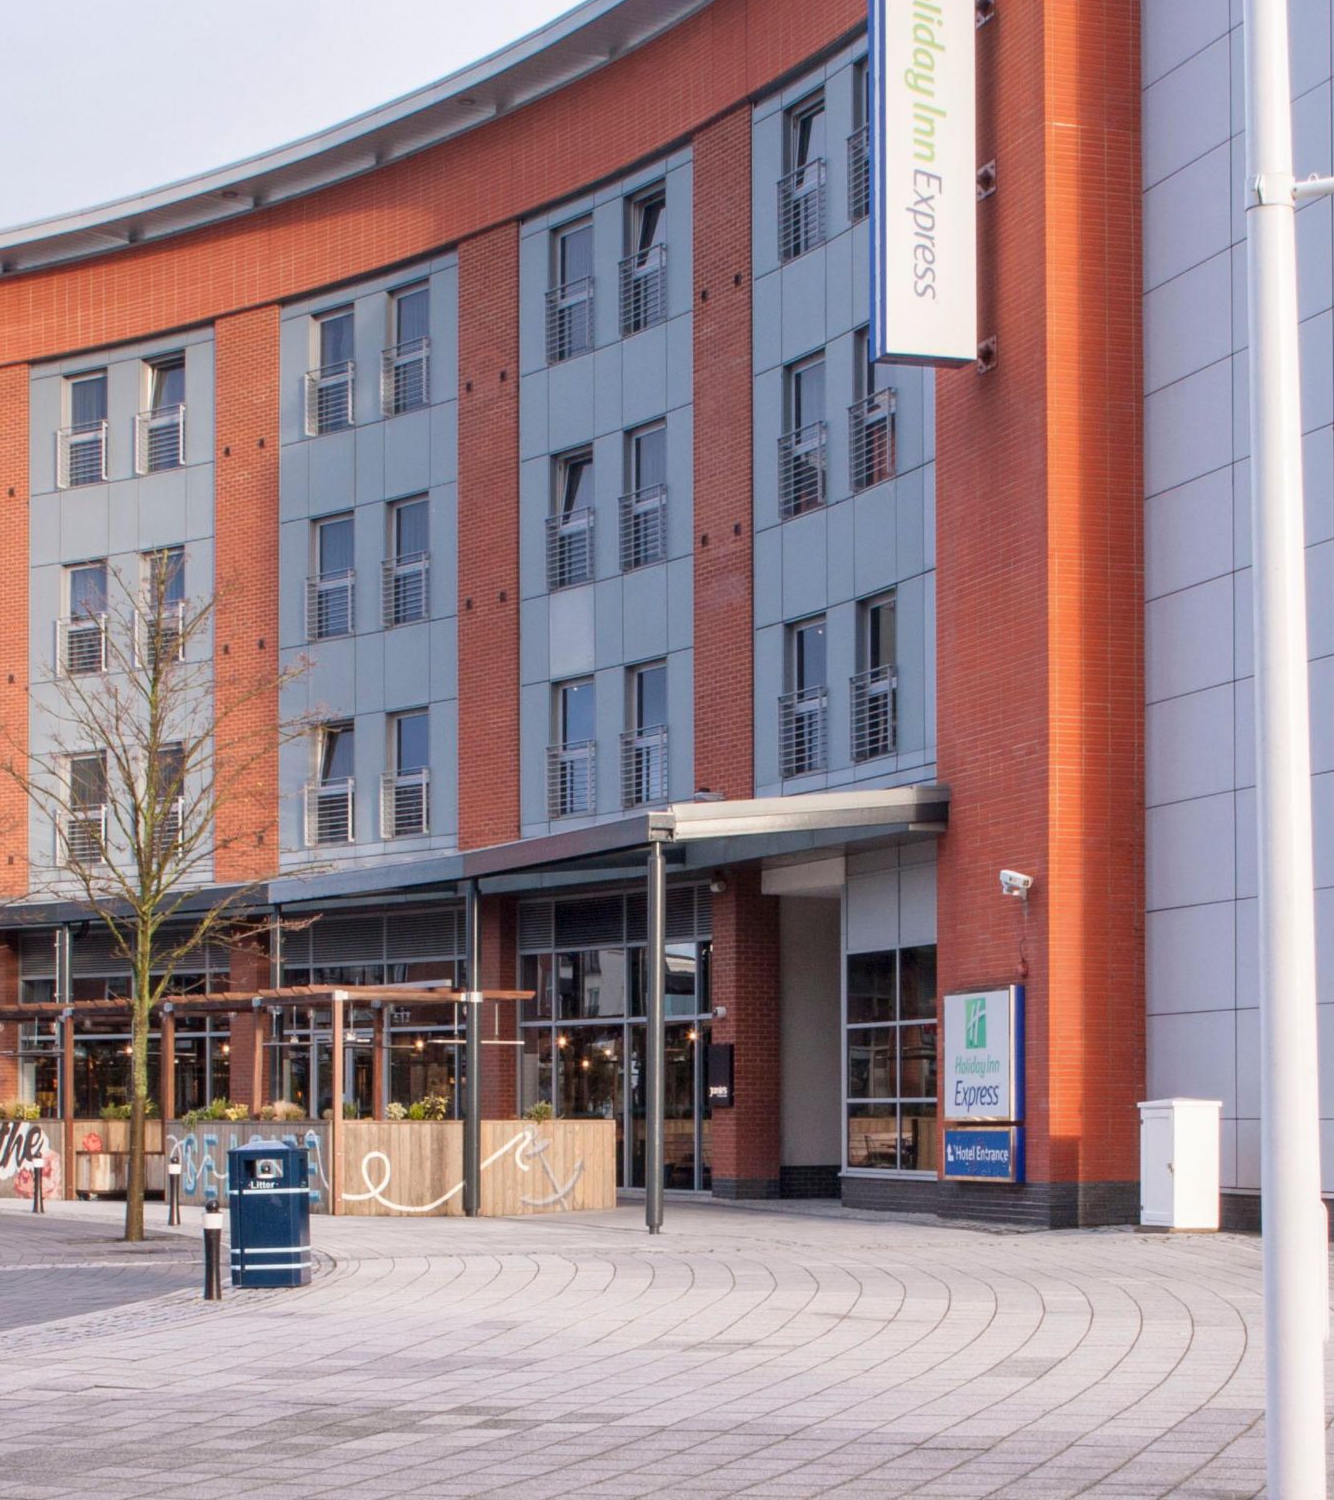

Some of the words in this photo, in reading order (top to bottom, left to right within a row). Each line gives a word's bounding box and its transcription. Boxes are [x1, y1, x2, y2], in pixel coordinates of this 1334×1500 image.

[913, 102, 947, 163] Inn
[905, 169, 943, 300] Express
[955, 1055, 985, 1078] Holiday
[986, 1054, 1000, 1073] Inn
[955, 1080, 999, 1113] Express
[955, 1145, 976, 1161] Hotel
[977, 1145, 1009, 1162] Entrance
[250, 1180, 276, 1189] Litter
